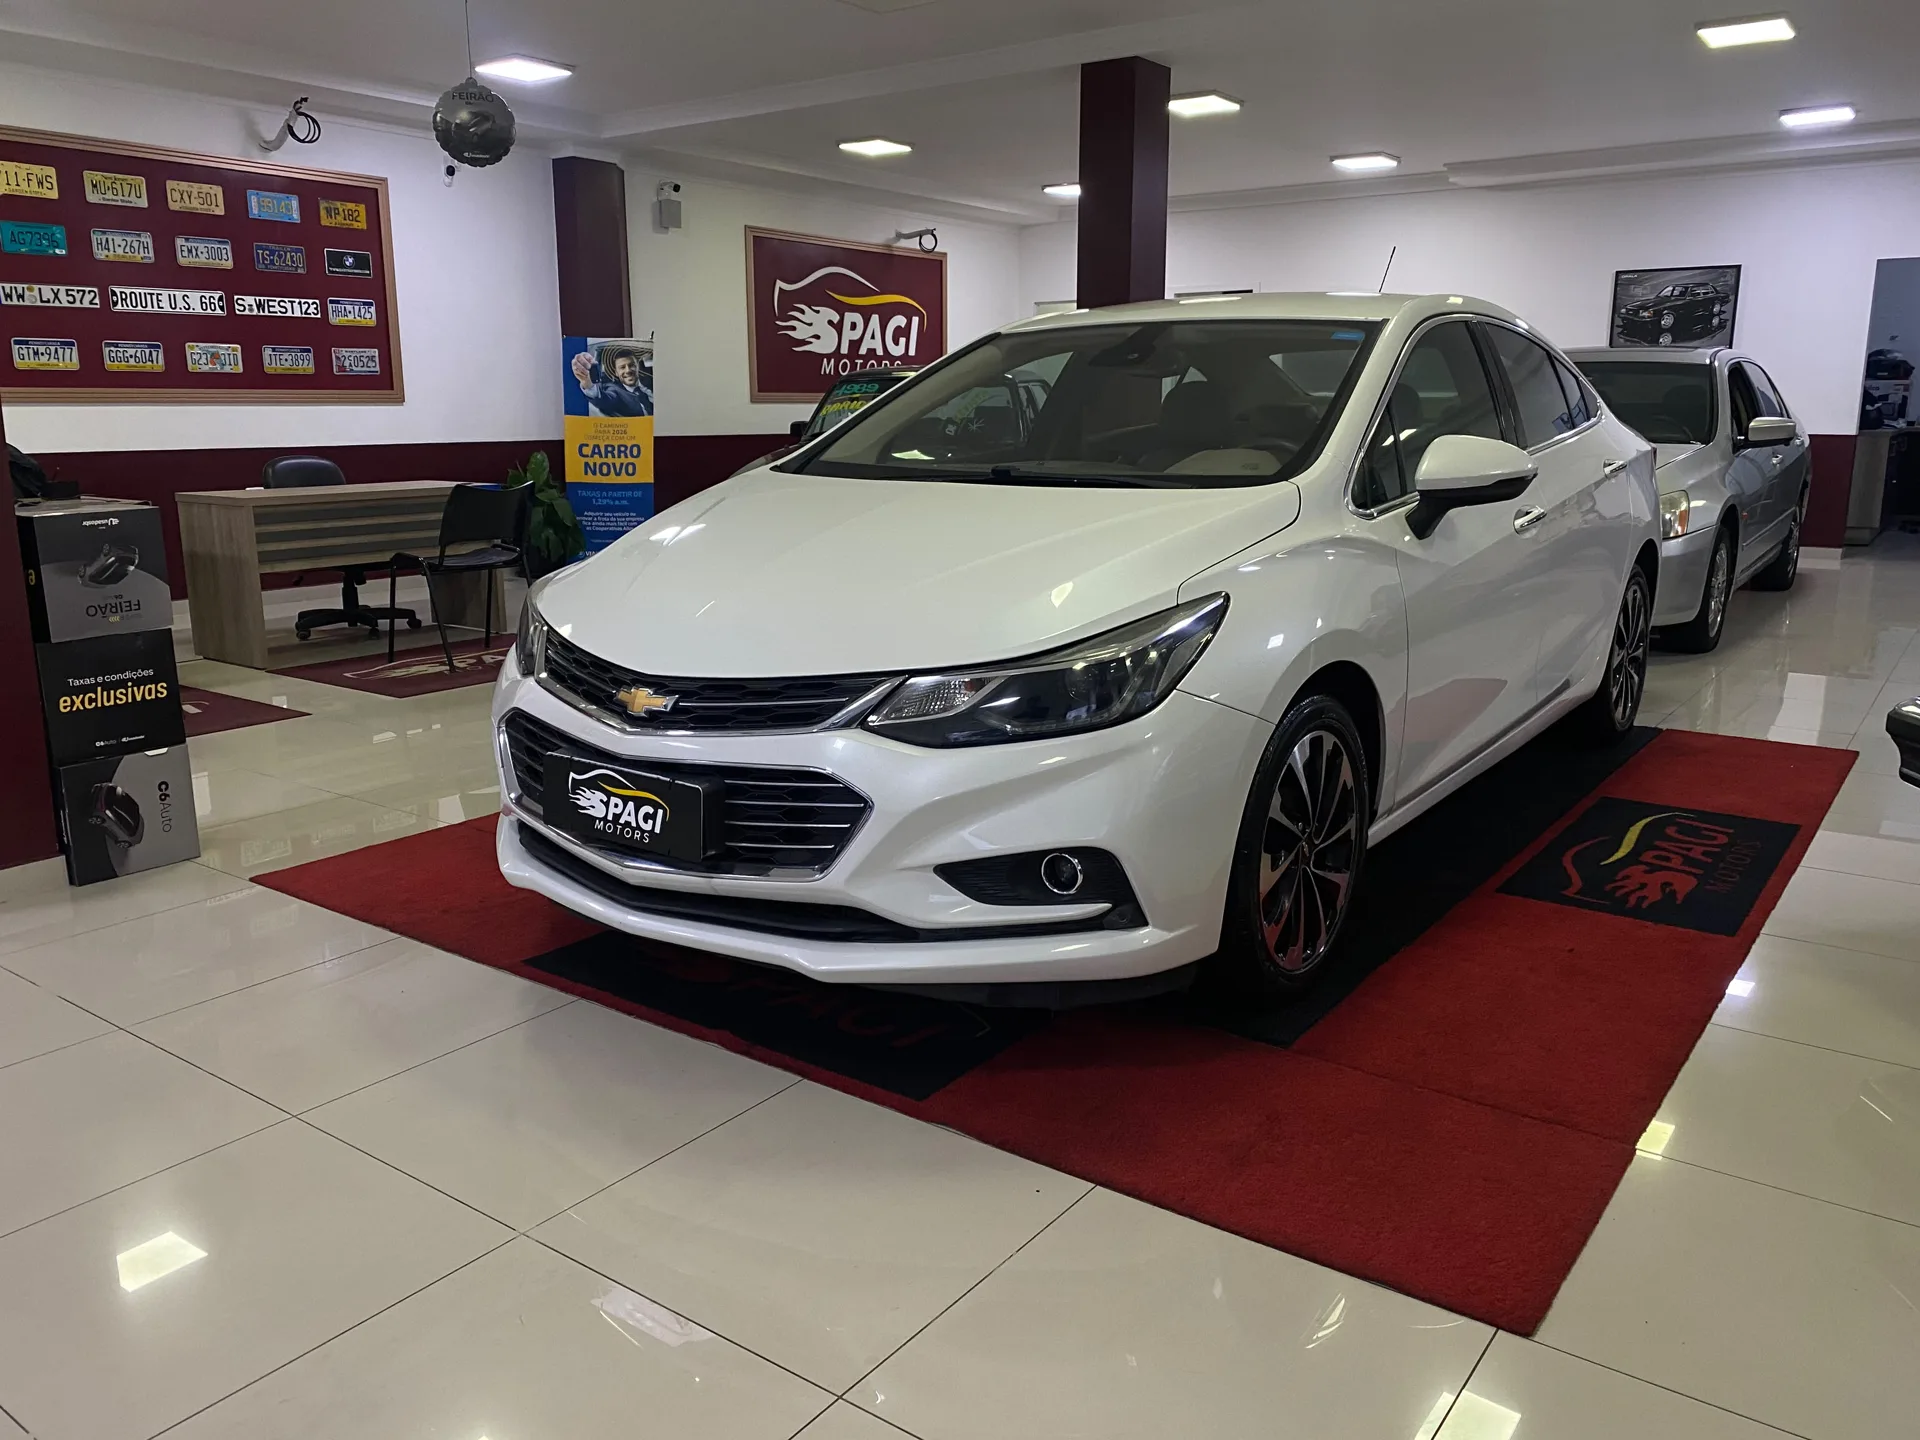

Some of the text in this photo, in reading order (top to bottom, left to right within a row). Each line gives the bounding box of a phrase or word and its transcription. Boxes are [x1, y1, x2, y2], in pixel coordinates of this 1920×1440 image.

[0, 170, 54, 191] 11-FWS
[169, 187, 220, 208] CXY-501
[38, 287, 61, 304] LX
[66, 288, 99, 306] 572
[119, 291, 217, 312] ROUTE U.S. 66
[775, 303, 920, 357] SPAGI
[578, 443, 641, 458] CARRO
[584, 461, 636, 476] NOVO
[85, 599, 141, 619] FEIRÃO
[67, 668, 154, 688] Taxas e condições
[58, 681, 168, 713] exclusivas
[568, 786, 664, 834] SPAGI
[594, 819, 650, 844] MOTORS
